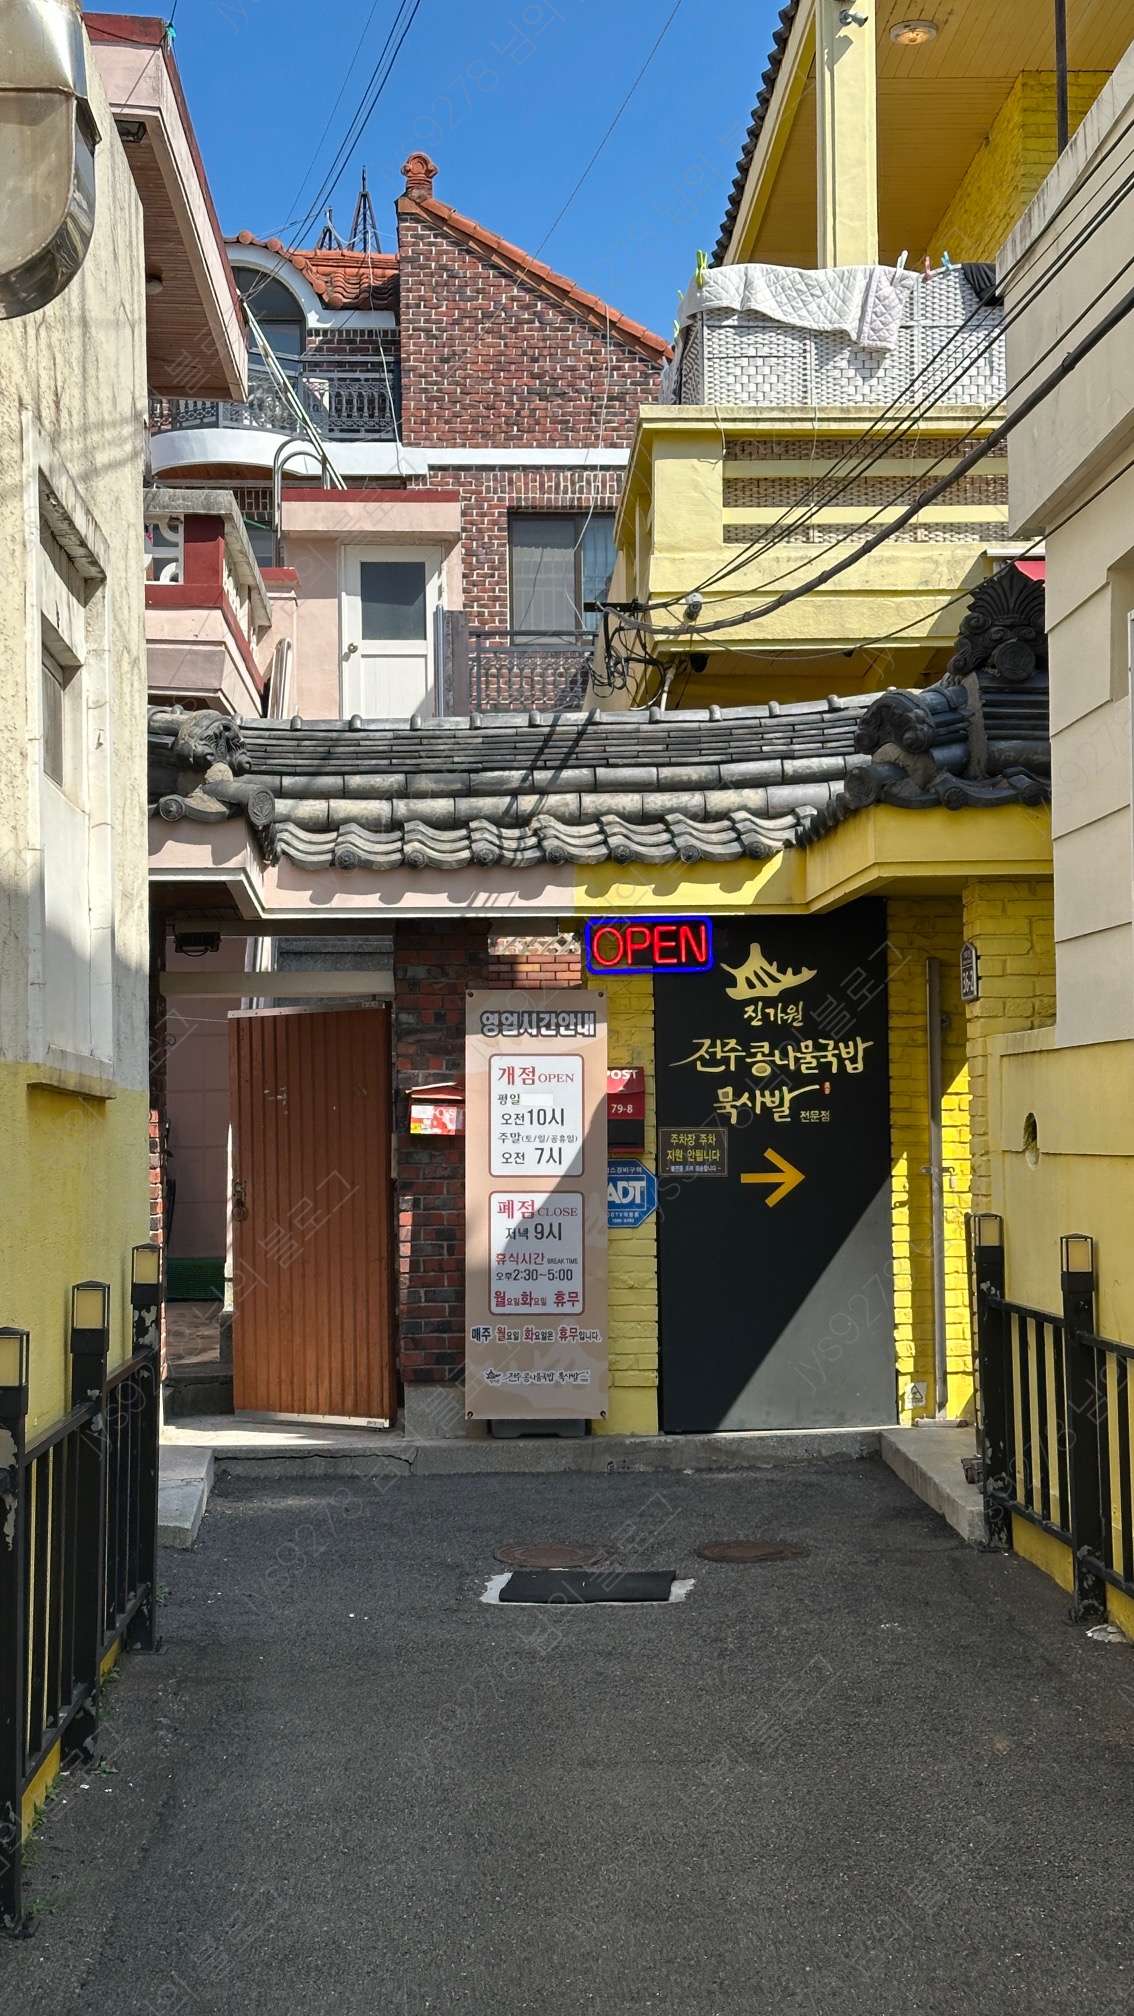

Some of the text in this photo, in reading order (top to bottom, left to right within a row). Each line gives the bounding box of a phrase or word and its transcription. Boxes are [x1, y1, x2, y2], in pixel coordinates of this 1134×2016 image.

[592, 925, 707, 966] OPEN
[743, 1000, 804, 1027] 진가원
[480, 1010, 597, 1038] 영업시간안내
[497, 1093, 521, 1106] 평일
[713, 1084, 820, 1125] 묵사발
[611, 1104, 634, 1114] 79-8
[799, 1109, 831, 1123] 전문점
[670, 1133, 716, 1147] 주차장 주차
[501, 1146, 563, 1166] 오전 7시
[666, 1149, 721, 1162] 지원 안됩니다
[607, 1166, 643, 1174] 스경비구역
[607, 1180, 647, 1204] ADT
[537, 1206, 579, 1217] CLOSE
[505, 1221, 563, 1242] 저녁 9시
[495, 1252, 579, 1266] 휴식시간 BREAK TIME
[553, 1290, 580, 1308] 휴무
[470, 1326, 492, 1343] 매주
[496, 1326, 520, 1342] 월요일
[523, 1326, 554, 1342] 화요일은
